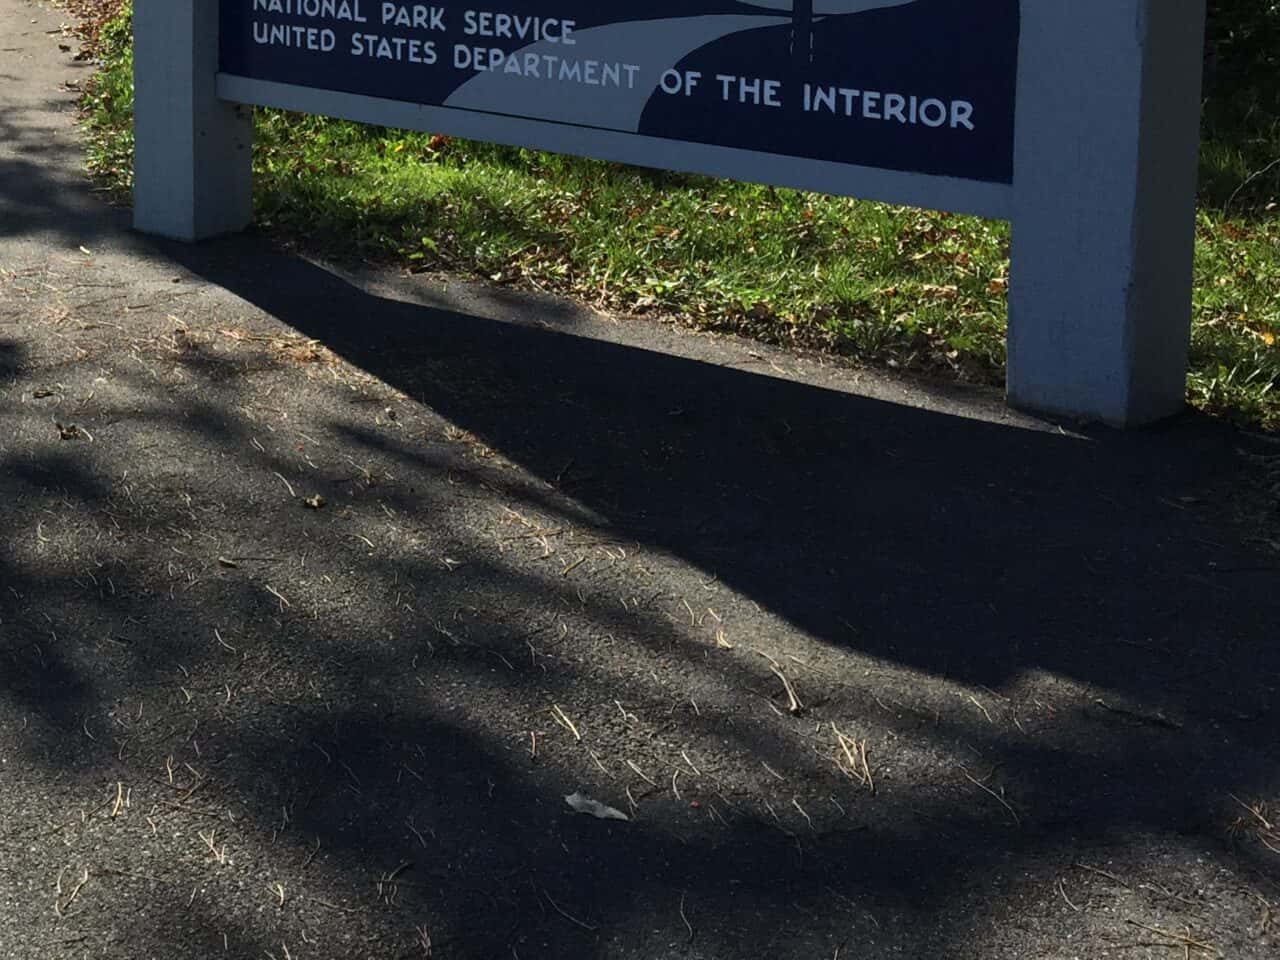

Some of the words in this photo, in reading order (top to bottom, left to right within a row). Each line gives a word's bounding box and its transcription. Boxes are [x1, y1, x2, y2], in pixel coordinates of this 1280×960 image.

[381, 2, 446, 32] PARK
[463, 10, 577, 45] SERVICE
[252, 22, 336, 52] UNITED
[351, 33, 437, 65] STATES
[454, 44, 640, 89] DEPARTMENT
[659, 68, 702, 96] OF
[716, 74, 782, 107] THE
[803, 83, 975, 131] INTERIOR
